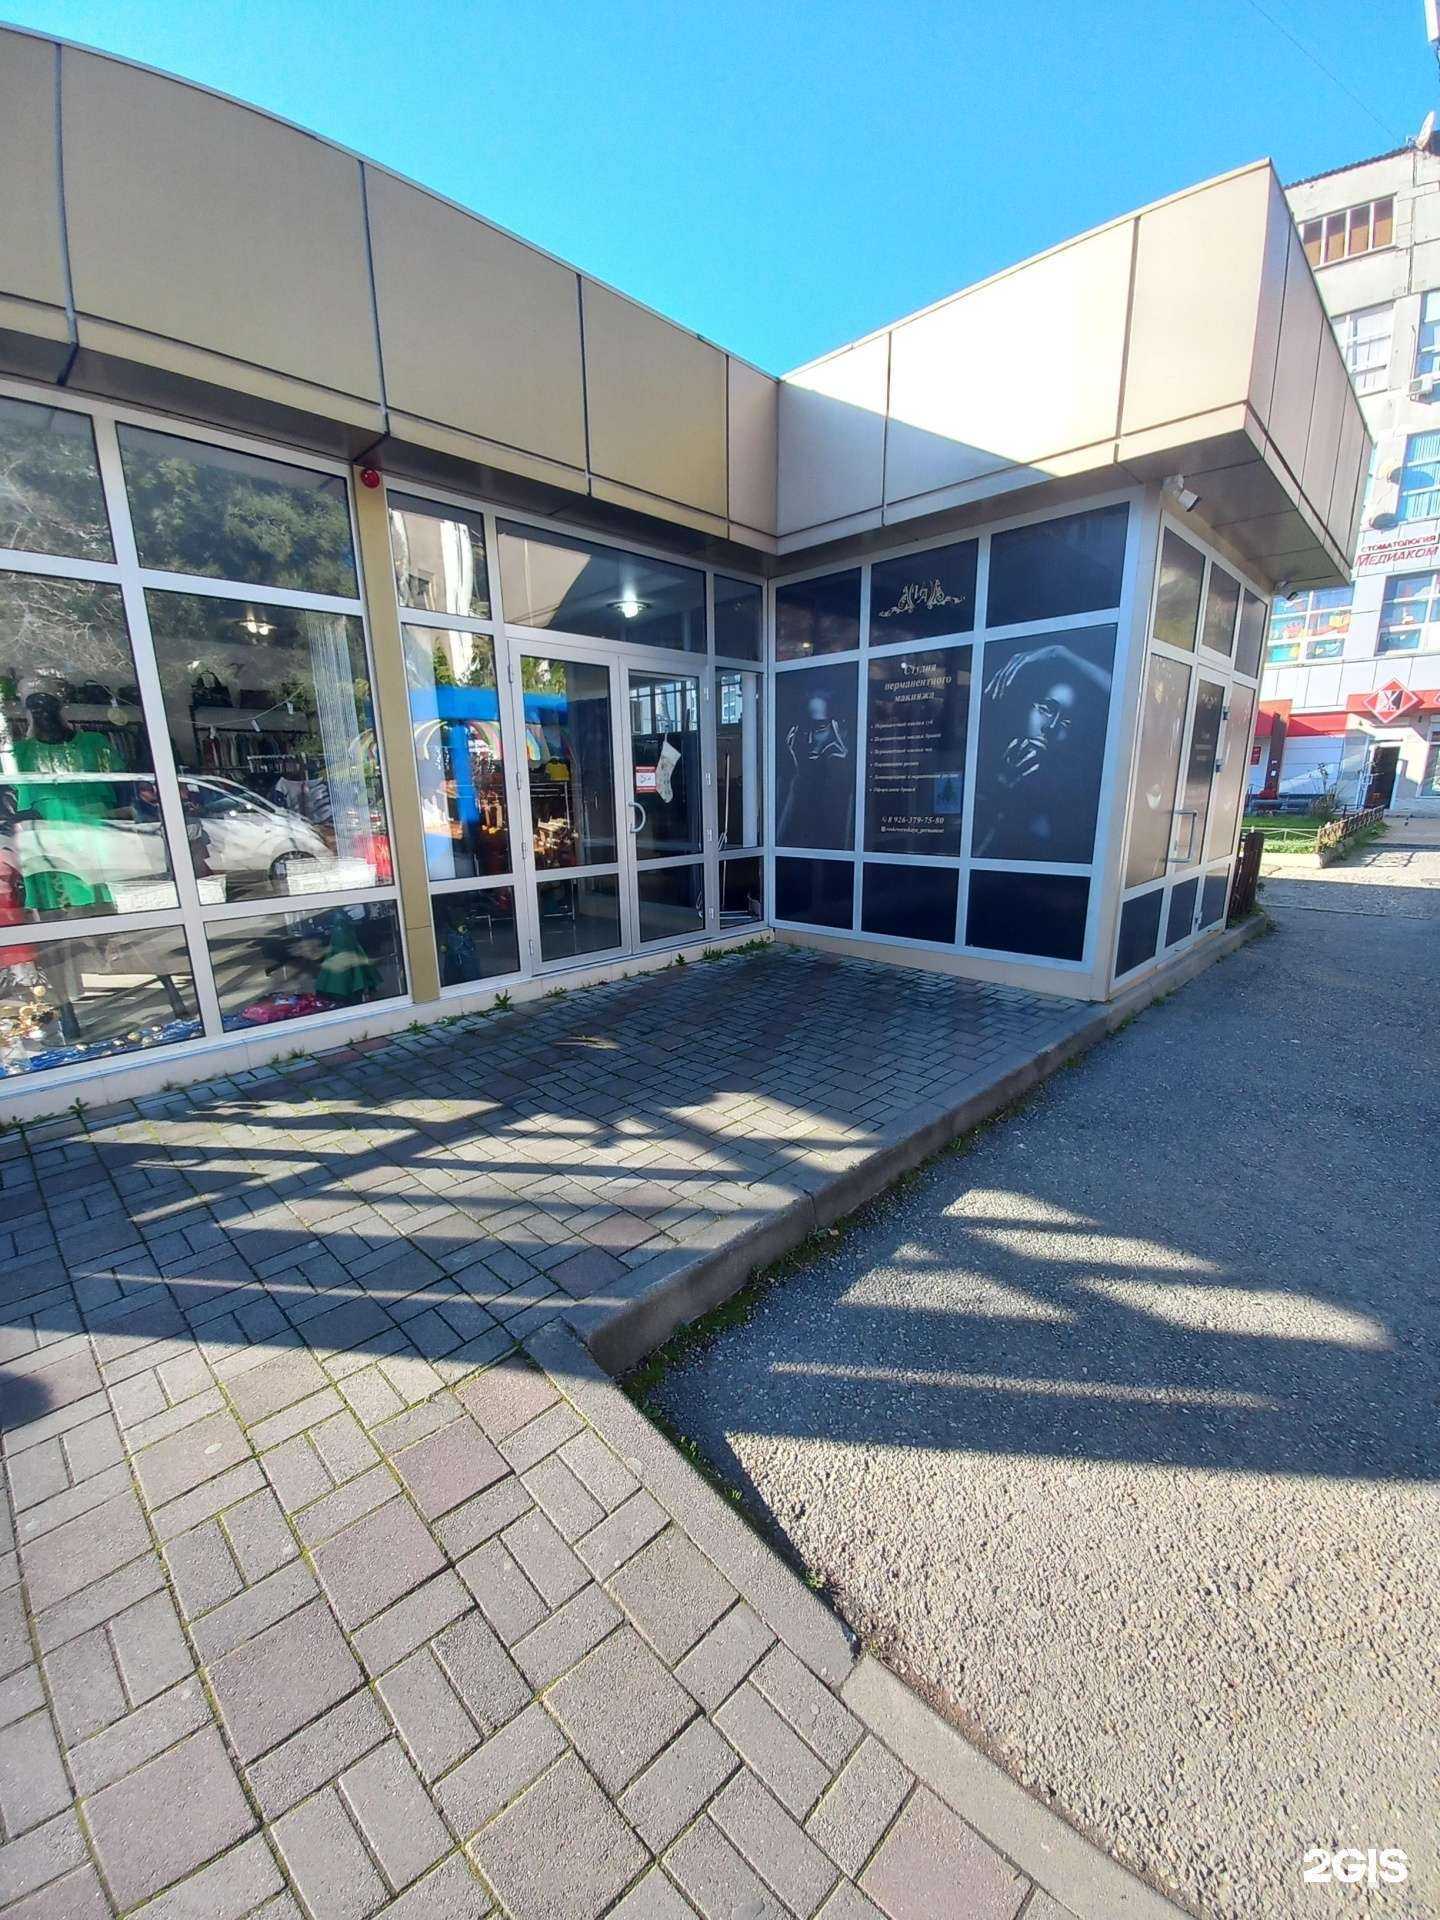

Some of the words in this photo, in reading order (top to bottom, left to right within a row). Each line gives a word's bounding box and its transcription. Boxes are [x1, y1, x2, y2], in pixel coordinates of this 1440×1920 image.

[903, 663, 937, 676] Студия
[884, 676, 952, 692] перманентного
[895, 691, 935, 703] макияжа
